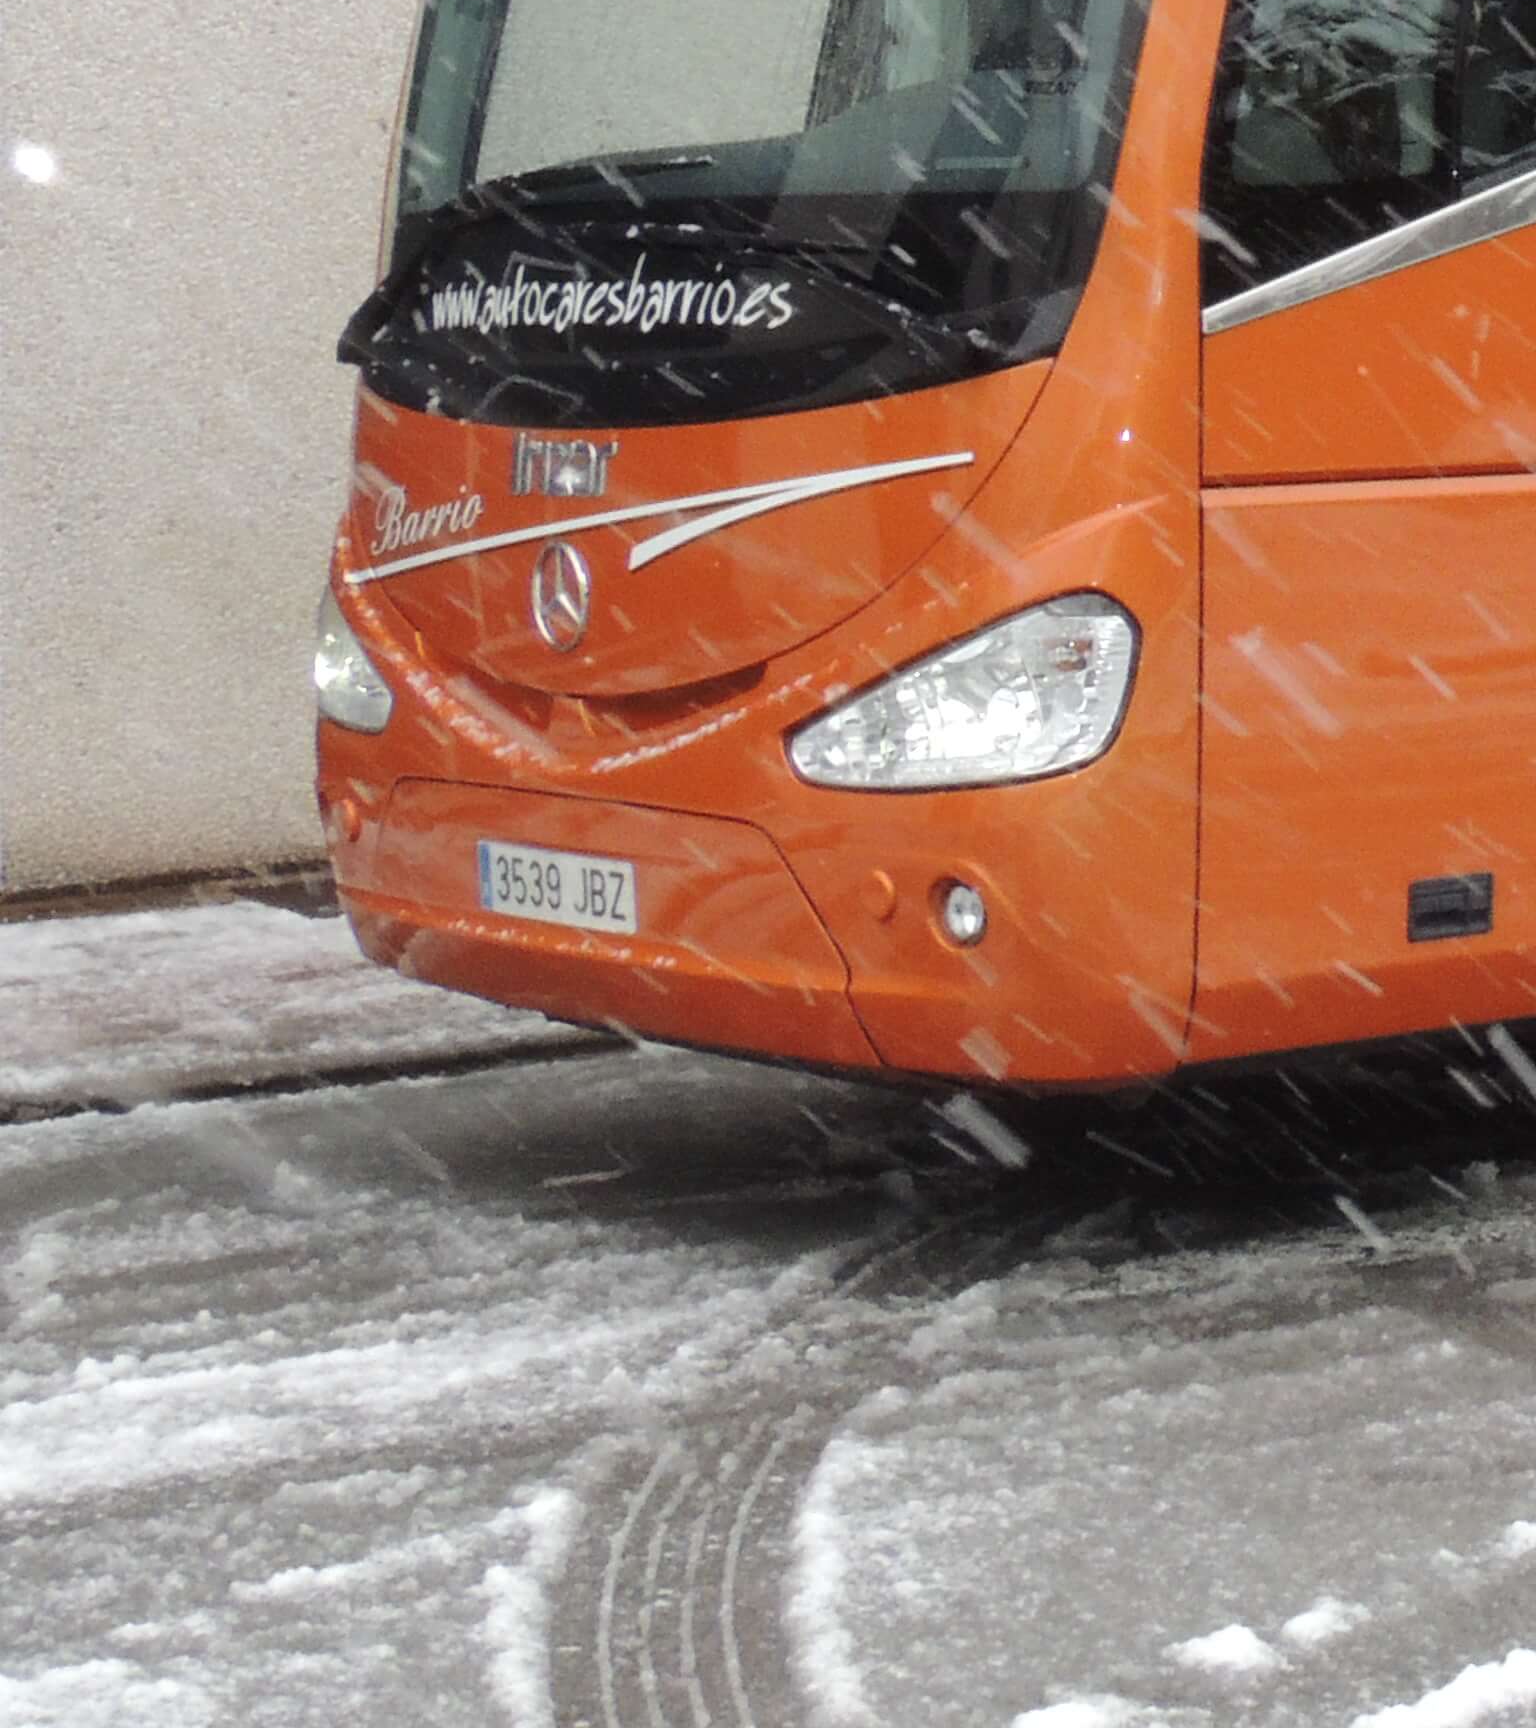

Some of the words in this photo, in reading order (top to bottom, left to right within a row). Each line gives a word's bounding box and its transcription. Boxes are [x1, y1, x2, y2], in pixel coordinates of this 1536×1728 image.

[431, 251, 795, 335] www.autocaresbarrio.es
[370, 484, 486, 556] Barrio
[496, 855, 562, 910] 3539
[572, 867, 627, 921] JBZ
